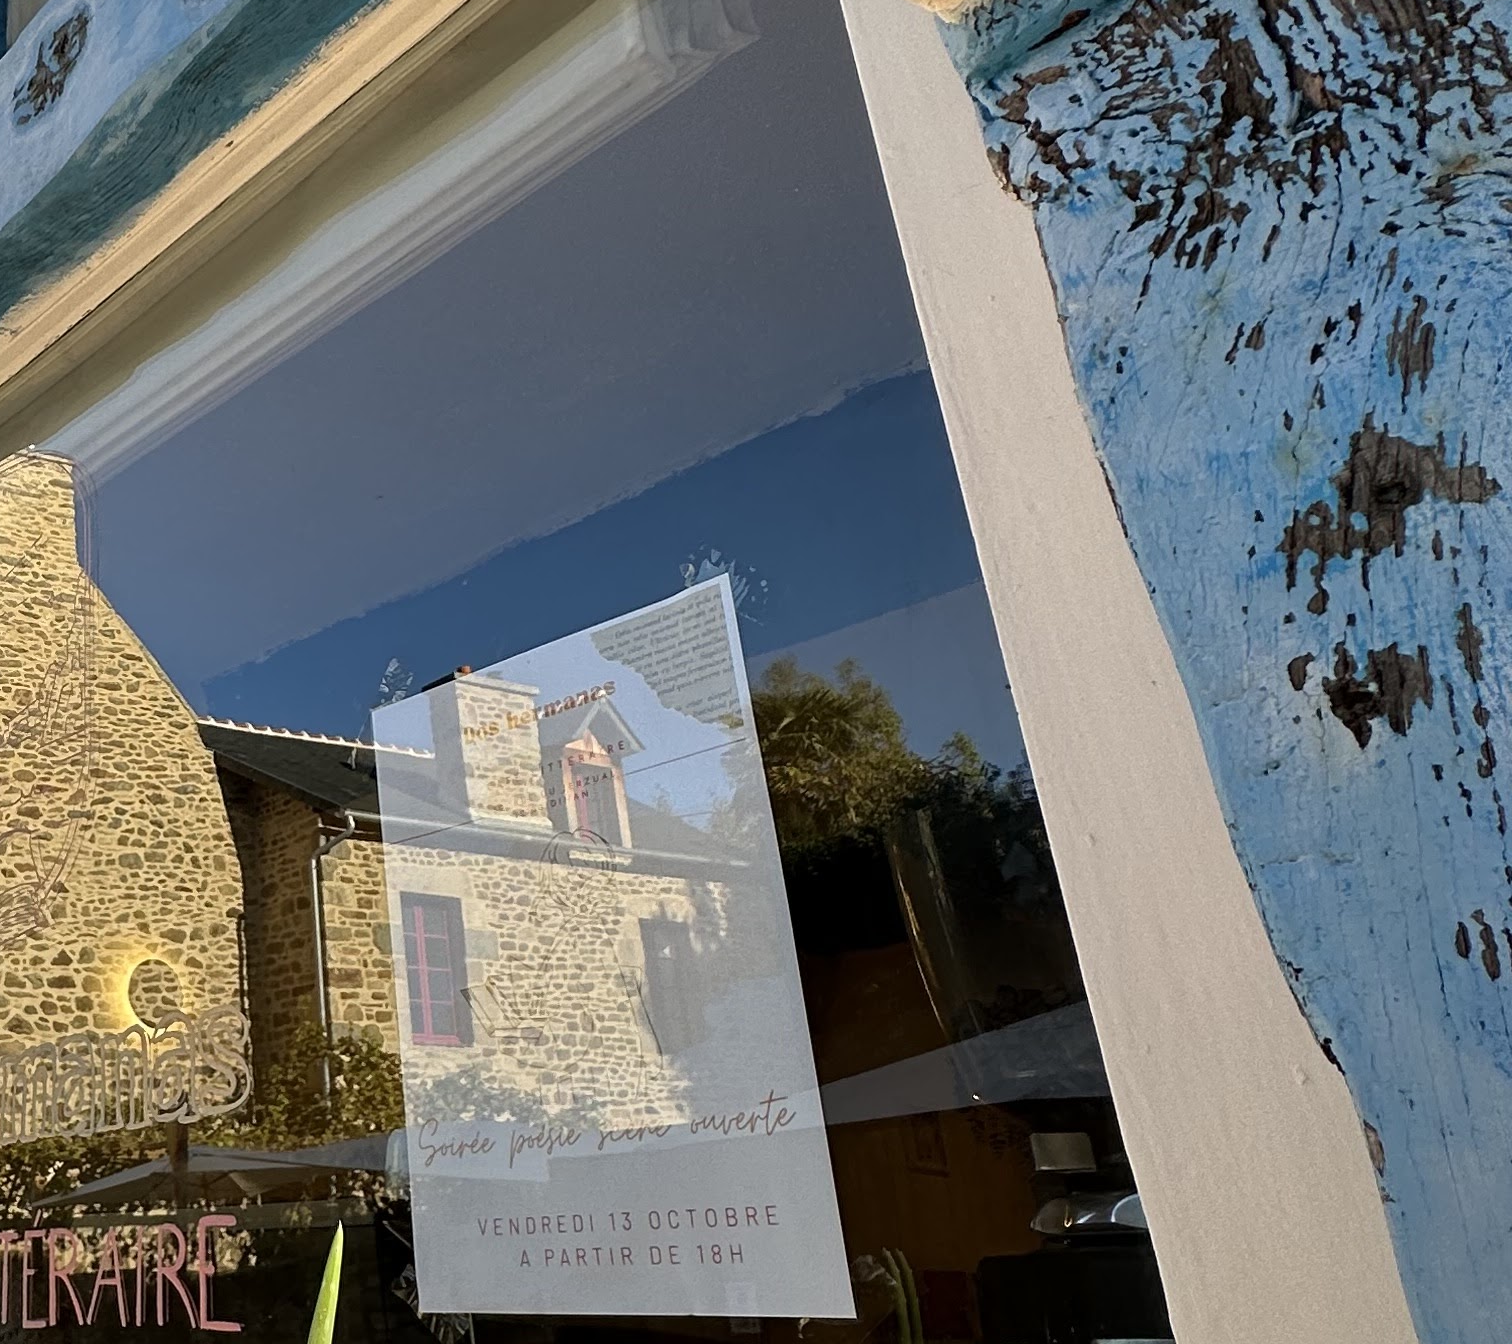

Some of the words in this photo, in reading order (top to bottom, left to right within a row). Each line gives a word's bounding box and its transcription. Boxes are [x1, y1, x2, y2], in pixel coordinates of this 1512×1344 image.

[418, 1117, 496, 1168] Soirée
[509, 1124, 584, 1168] poésie
[690, 1089, 797, 1137] ouverte
[477, 1213, 595, 1237] VENDREDI
[608, 1211, 634, 1232] 13
[648, 1205, 781, 1231] OCTOBRE
[519, 1249, 532, 1267] A
[545, 1246, 635, 1267] PARTIR
[649, 1245, 682, 1266] DE
[696, 1243, 745, 1265] 18H
